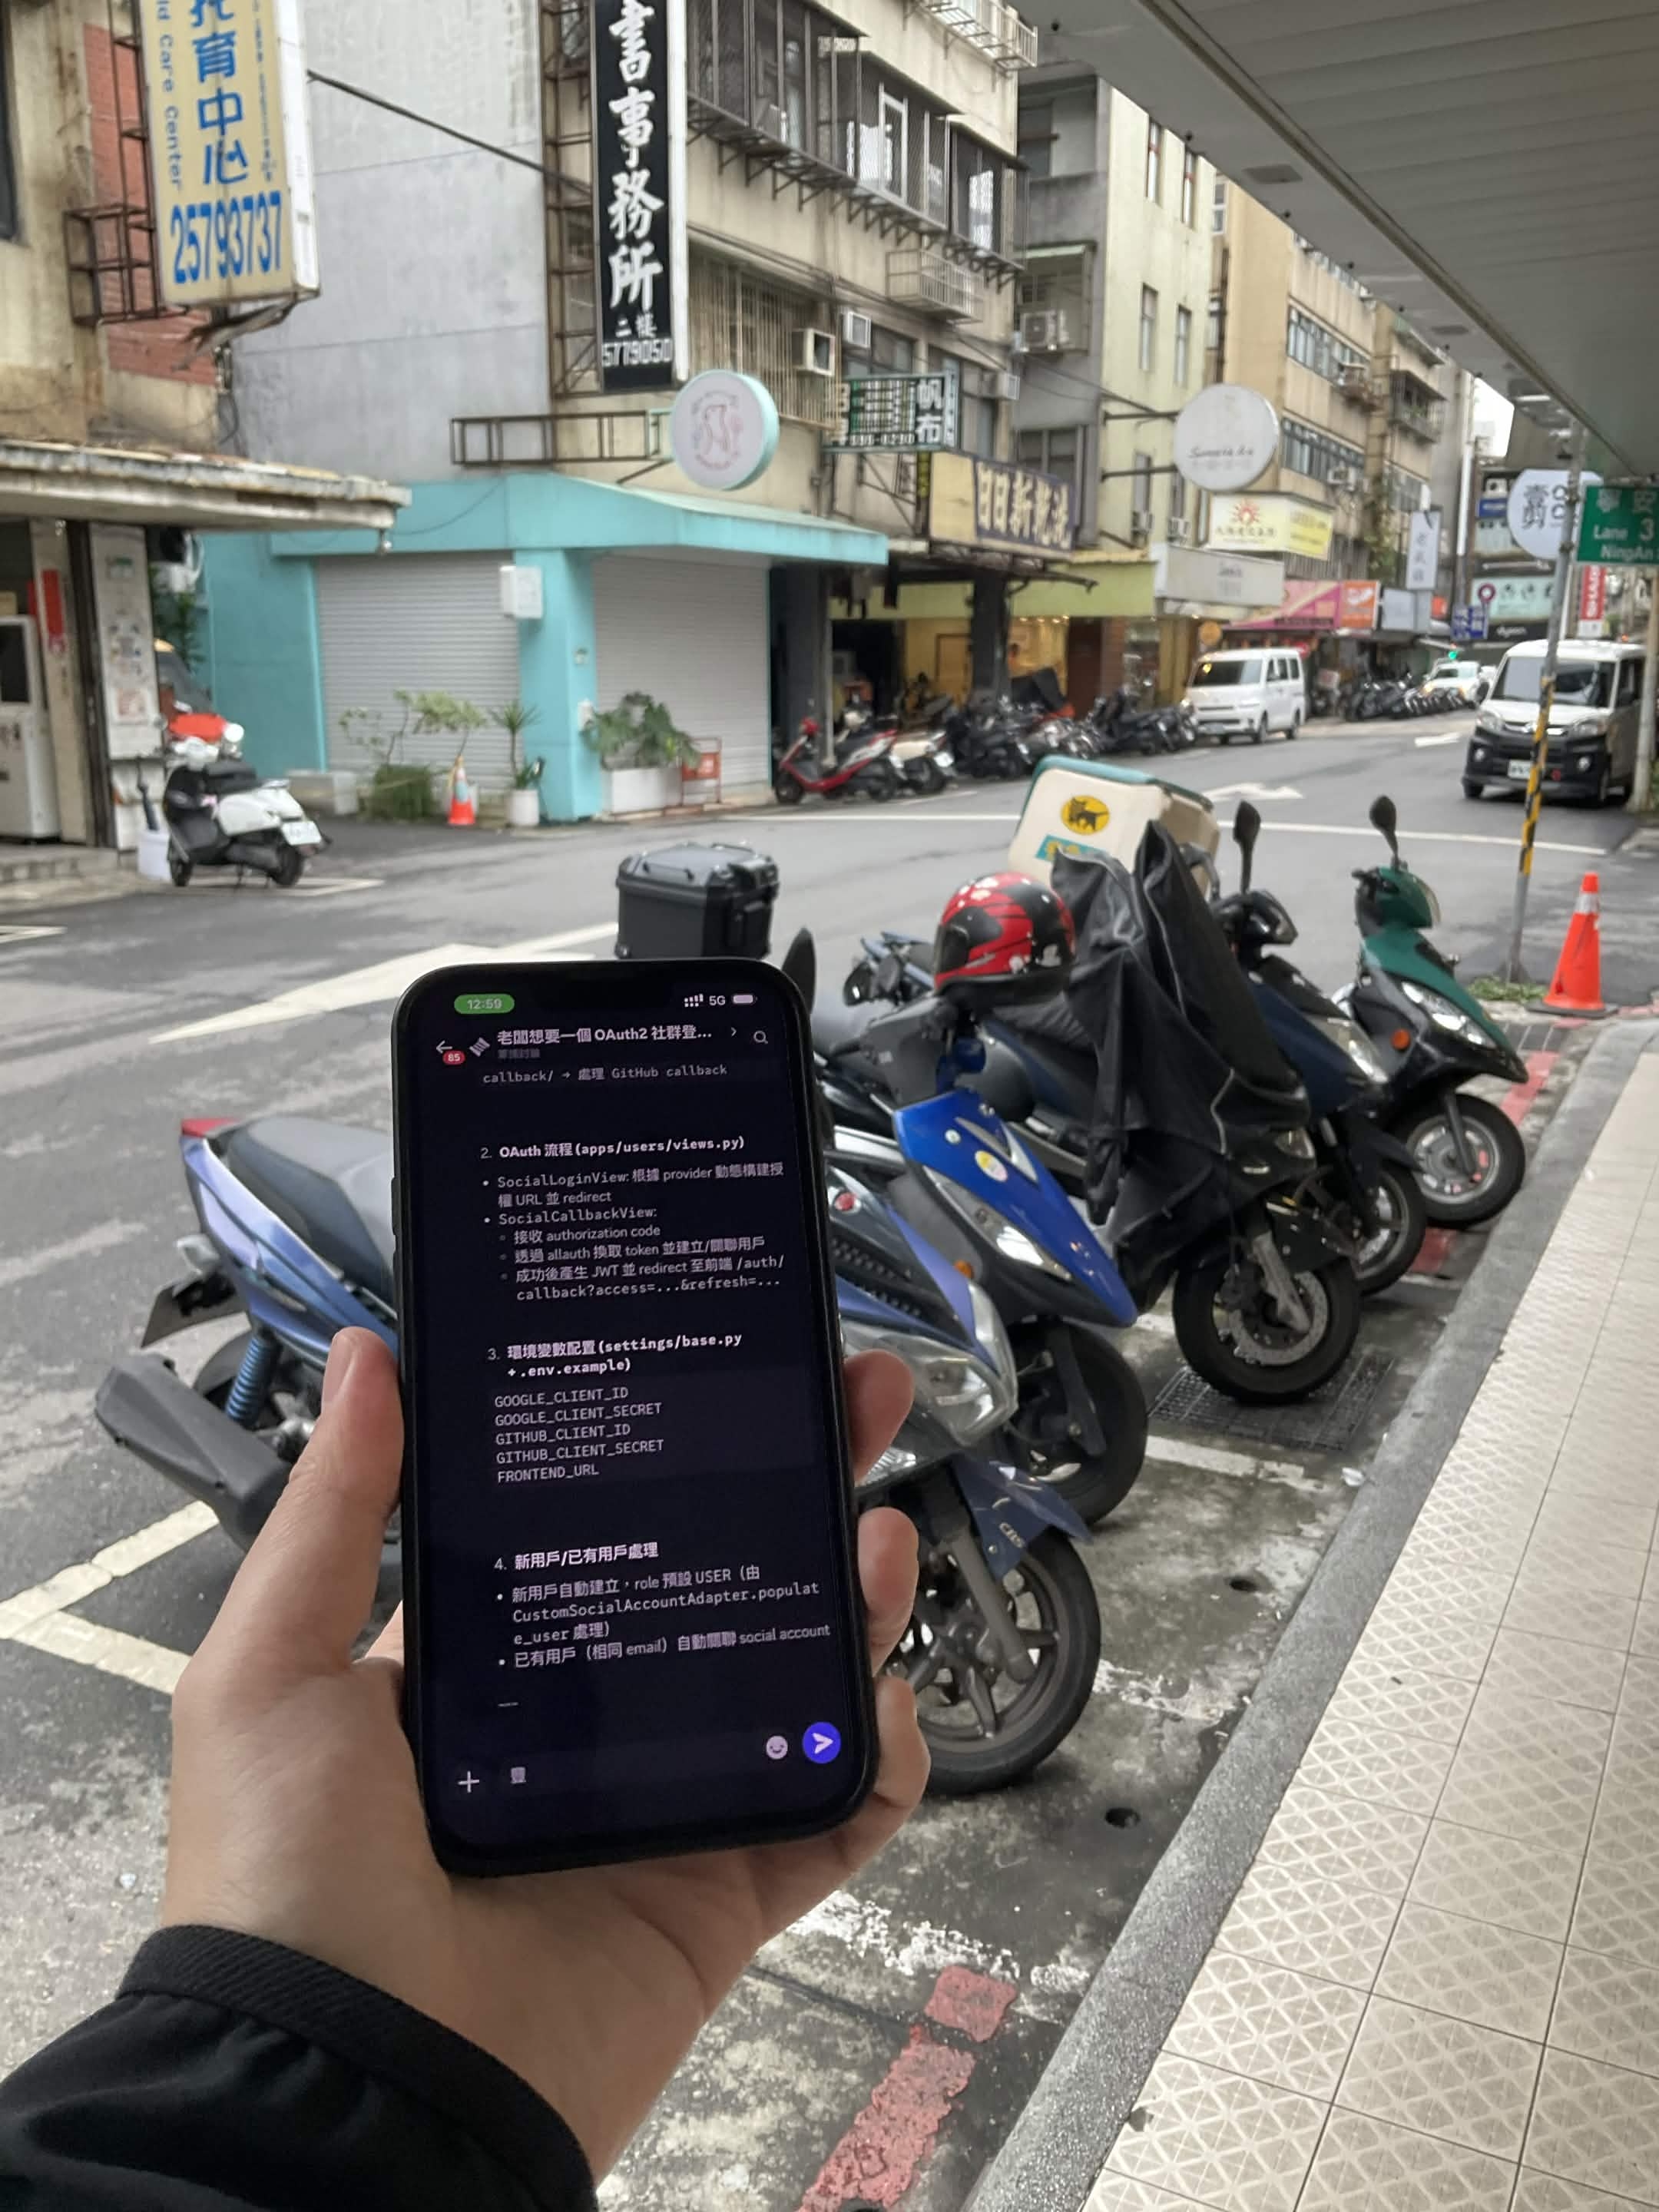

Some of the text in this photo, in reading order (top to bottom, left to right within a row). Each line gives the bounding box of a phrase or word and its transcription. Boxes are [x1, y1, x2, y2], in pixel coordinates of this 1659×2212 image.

[159, 35, 174, 92] Care
[164, 106, 182, 190] Center
[171, 191, 281, 284] 25793737
[916, 379, 942, 442] 帆布
[1593, 525, 1628, 541] Lane
[1601, 545, 1654, 562] NingAn
[467, 995, 726, 1010] 12:59 5G
[594, 1027, 648, 1041] OAuth2
[448, 1053, 461, 1062] 85
[483, 1070, 553, 1083] callback/
[612, 1067, 658, 1078] GitHub
[667, 1064, 727, 1077] callback
[499, 1144, 541, 1157] OAuth
[498, 1172, 629, 1188] SocialLoginView:
[664, 1167, 713, 1182] provider
[516, 1194, 542, 1206] URL
[563, 1191, 612, 1204] redirect
[499, 1207, 657, 1224] SocialCallbackView:
[514, 1224, 661, 1245] 接收 authorization code
[548, 1247, 590, 1260] allauth
[625, 1243, 659, 1257] token
[516, 1265, 588, 1283] 成功後產生
[591, 1264, 620, 1278] JWT
[639, 1262, 687, 1275] redirect
[690, 1257, 733, 1273] 至前端
[737, 1254, 784, 1270] /auth/
[495, 1387, 628, 1408] GOOGLE_CLIENT_ID
[495, 1402, 662, 1426] GOOGLE_CLIENT_SECRET
[496, 1424, 631, 1445] GITHUB_CLIENT_ID
[496, 1439, 664, 1463] GITHUB_CLIENT_SECRET
[498, 1464, 599, 1483] FRONTEND_URL
[494, 1542, 659, 1571] 4. 新用戶/已有用戶處理
[634, 1576, 659, 1590] role
[695, 1568, 731, 1584] USER
[513, 1582, 820, 1622] CustomSocialAccountAdapter.populat
[514, 1630, 569, 1645] e_user
[515, 1647, 576, 1668] 已有用戶
[740, 1628, 776, 1644] social
[780, 1624, 830, 1641] account
